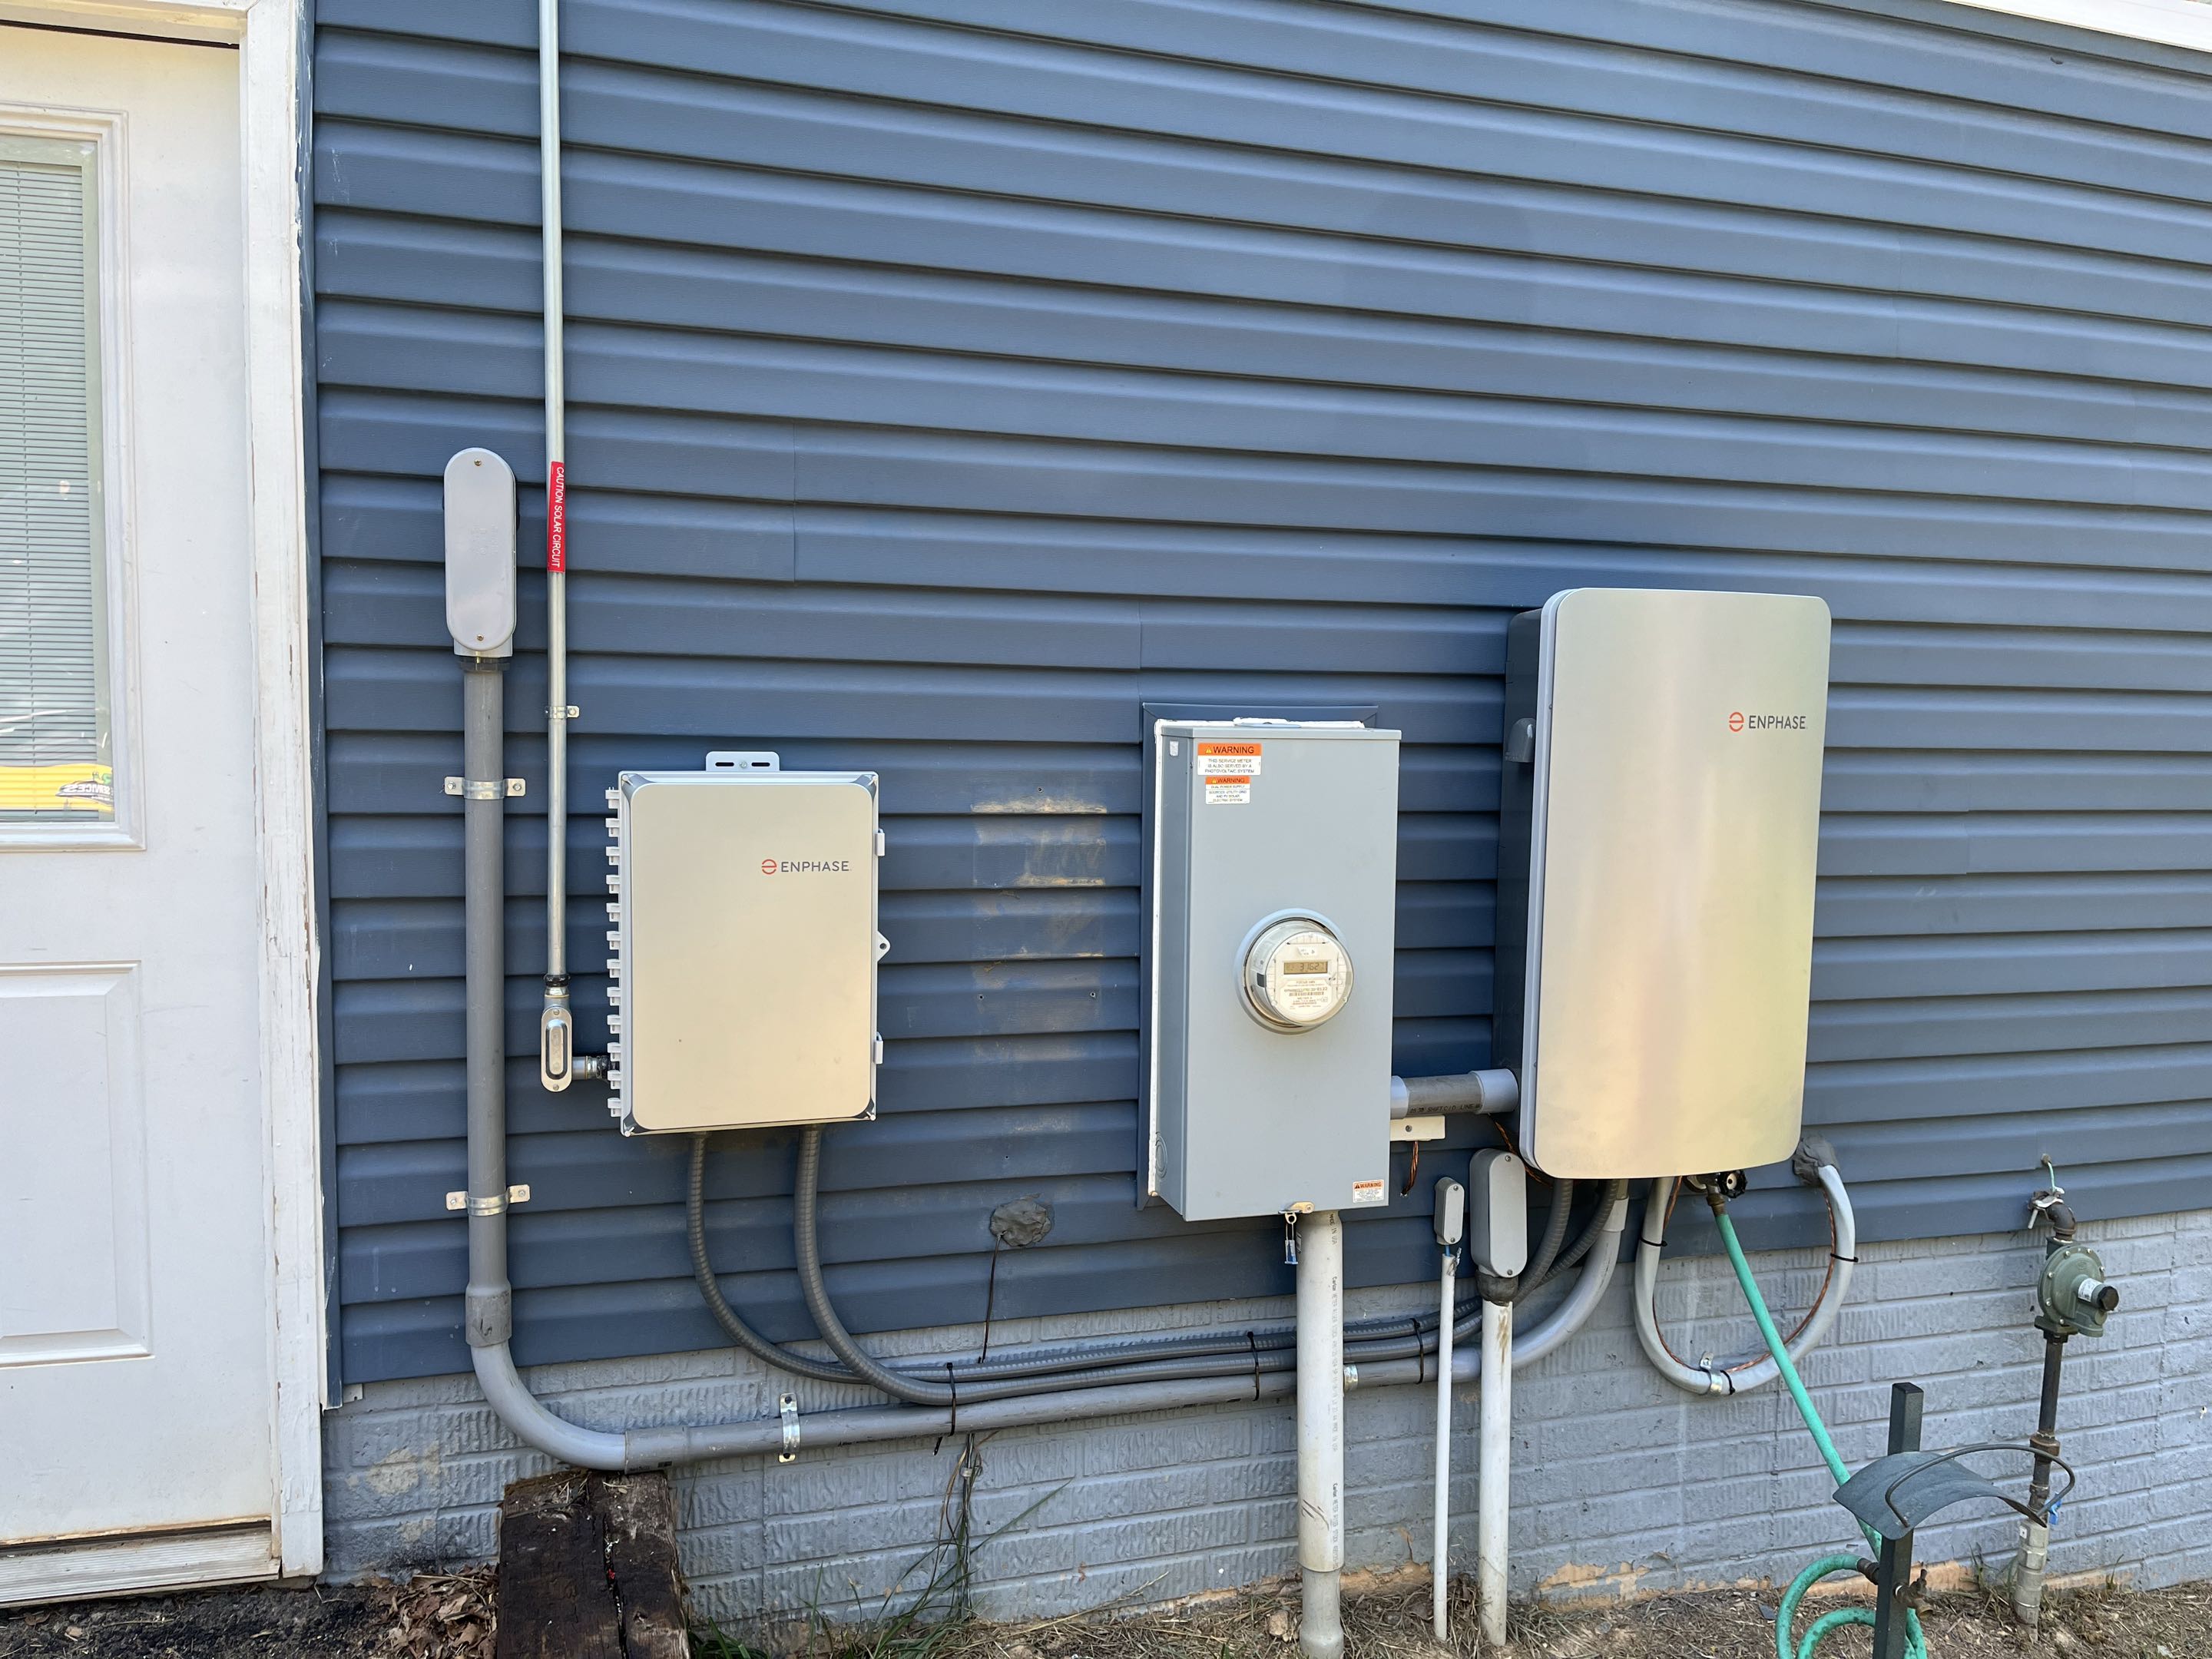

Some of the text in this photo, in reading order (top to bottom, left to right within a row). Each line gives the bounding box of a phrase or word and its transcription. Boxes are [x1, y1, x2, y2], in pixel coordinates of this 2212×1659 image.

[551, 466, 565, 568] CAUTION SOLAR CIRCUIT
[1748, 715, 1806, 730] ENPHASE
[1214, 746, 1254, 754] WARNING
[780, 860, 850, 873] ENPHASE
